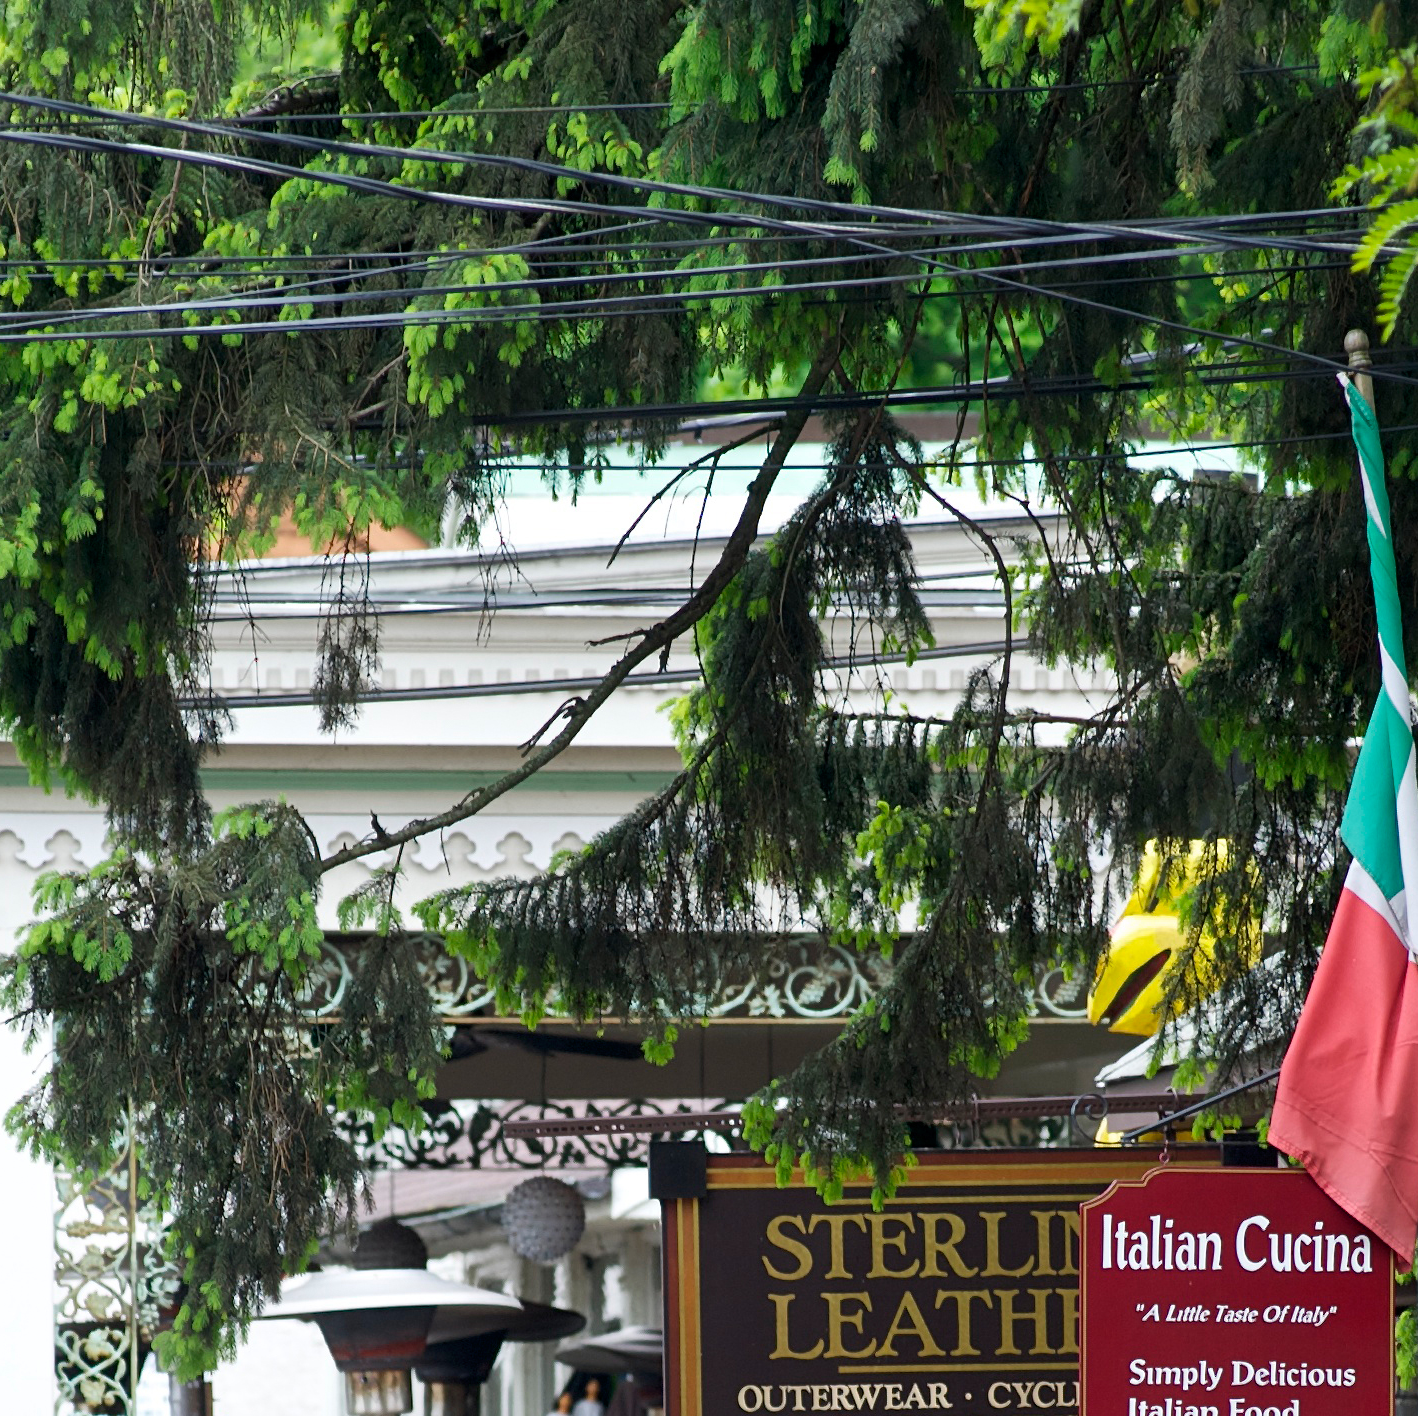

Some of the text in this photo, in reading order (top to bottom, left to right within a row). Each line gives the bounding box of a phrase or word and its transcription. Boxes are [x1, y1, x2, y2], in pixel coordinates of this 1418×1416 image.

[1101, 1213, 1373, 1273] Italian Cucina
[1135, 1303, 1338, 1327] "A Little Taste Of Italy"
[1129, 1358, 1357, 1391] Simply Delicious
[737, 1380, 1080, 1413] OUTERWEAR CYCL
